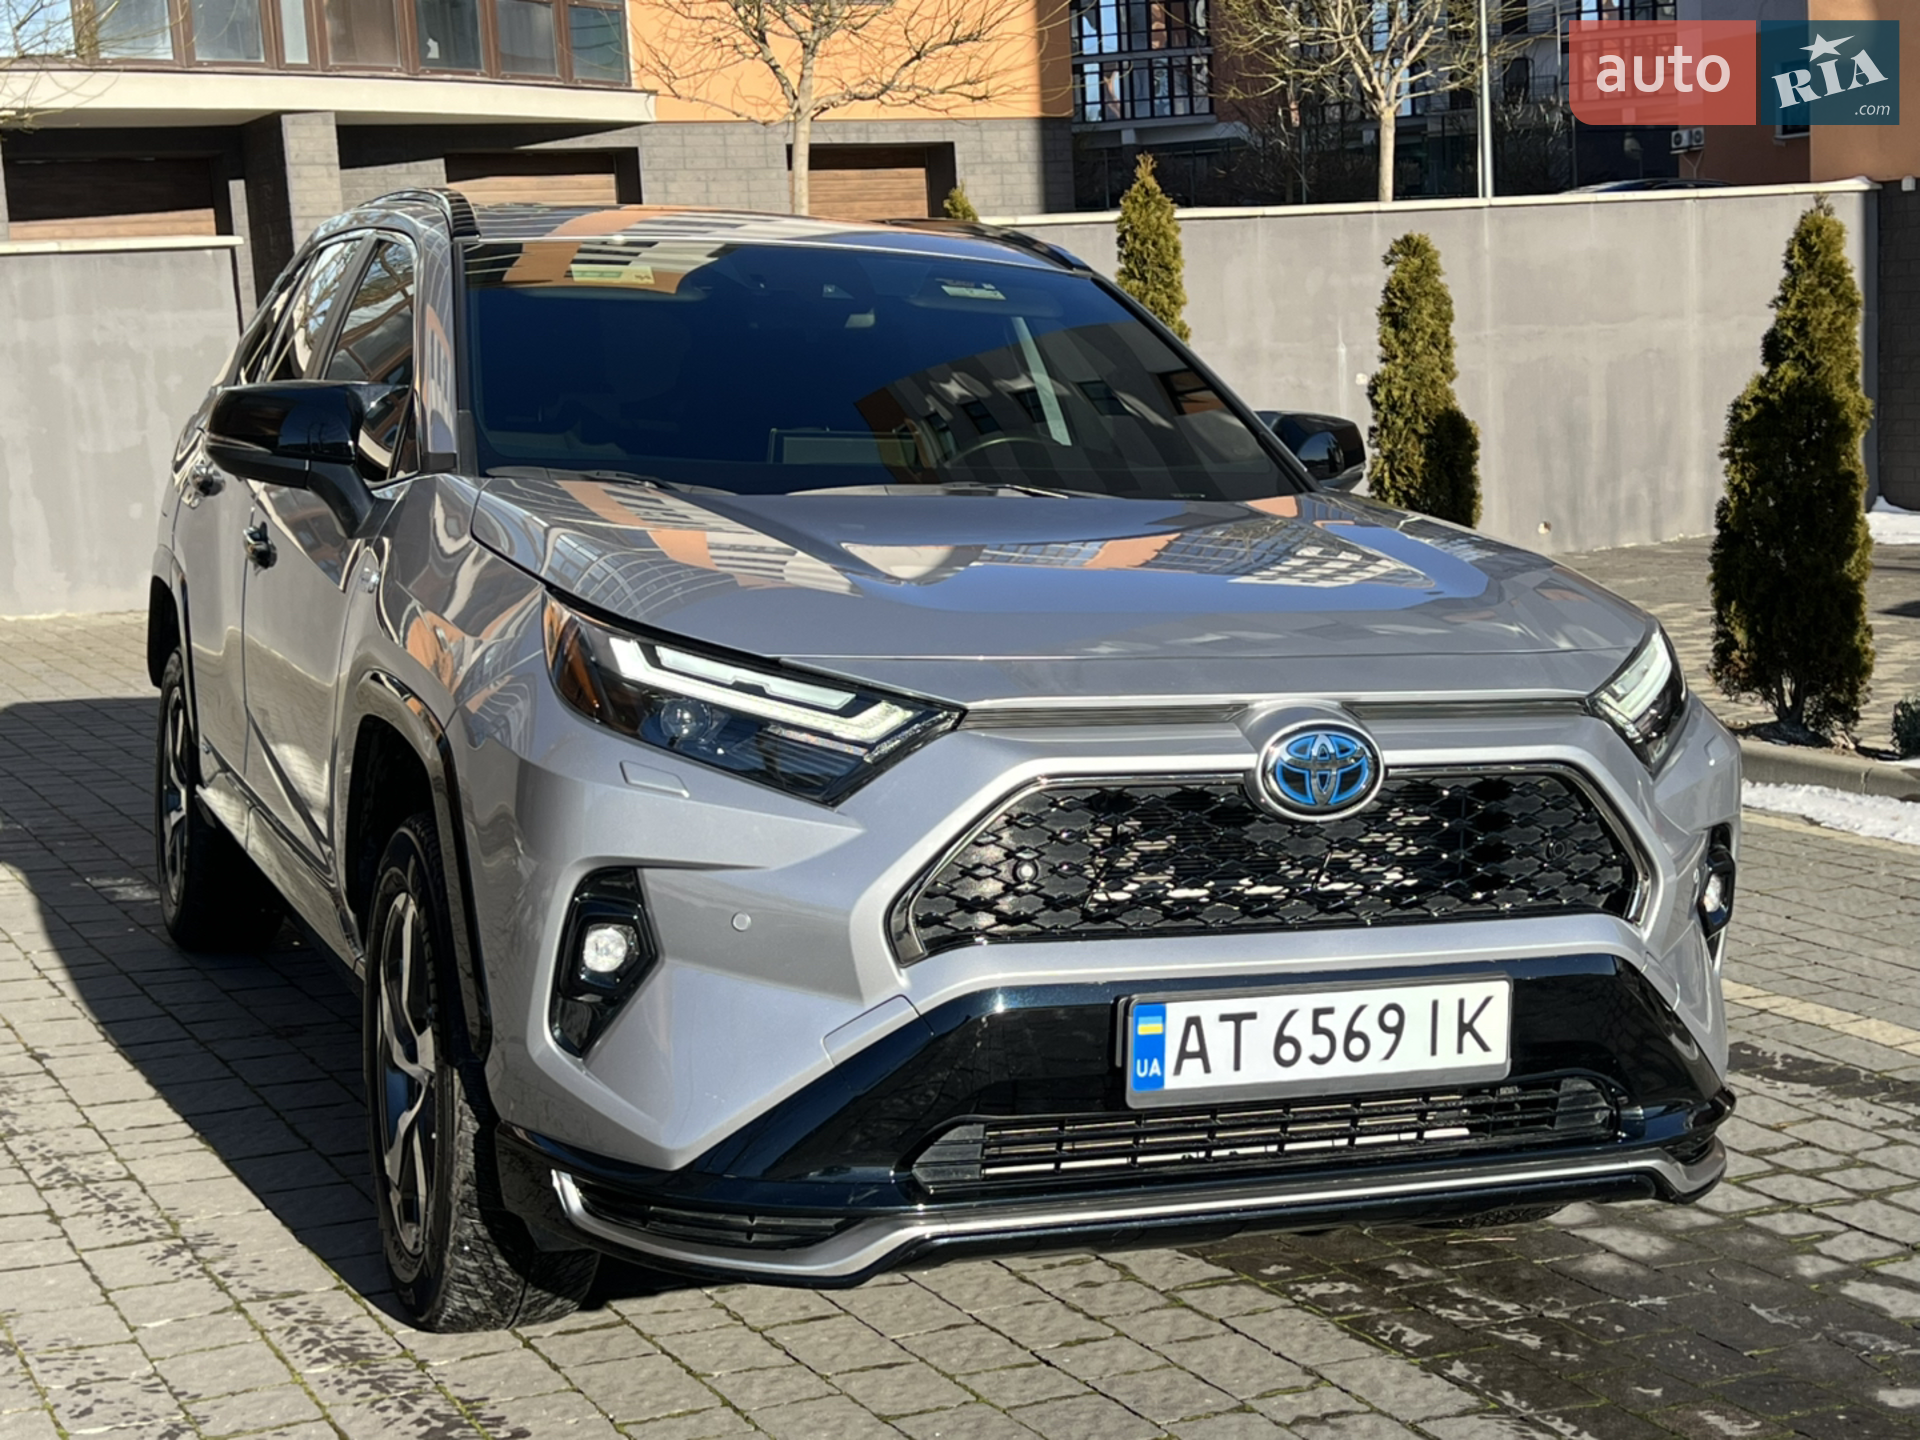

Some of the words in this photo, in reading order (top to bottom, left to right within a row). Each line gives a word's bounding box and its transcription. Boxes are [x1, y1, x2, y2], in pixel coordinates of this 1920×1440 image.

[1173, 1011, 1257, 1076] AT
[1273, 1002, 1406, 1068] 6569
[1430, 995, 1494, 1057] IK
[1136, 1057, 1162, 1078] UA
